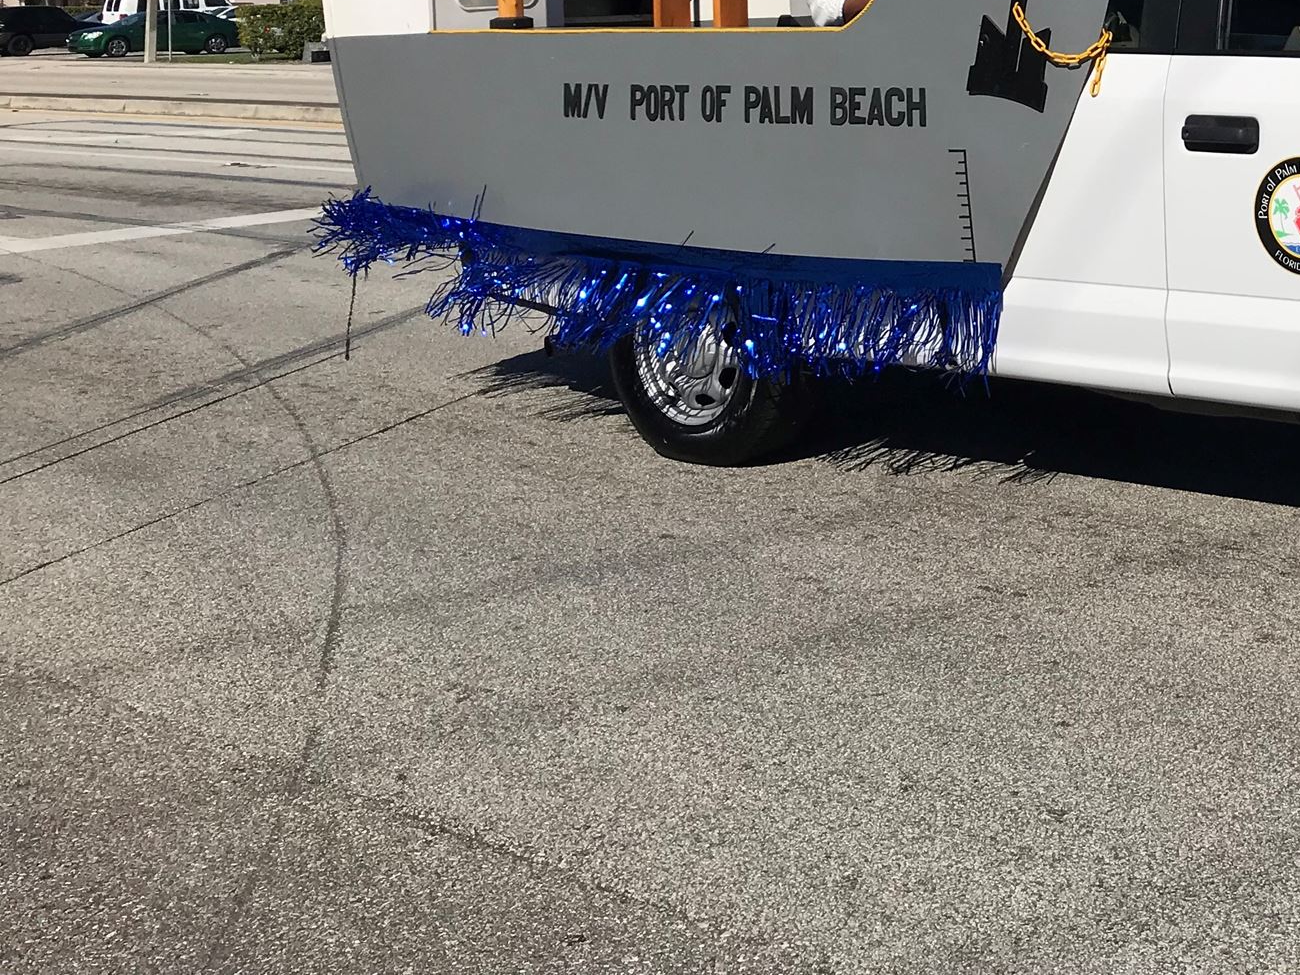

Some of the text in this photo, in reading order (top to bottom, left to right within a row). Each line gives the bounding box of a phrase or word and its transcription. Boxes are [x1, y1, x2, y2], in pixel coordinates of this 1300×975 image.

[563, 83, 927, 127] M/V PORT OF PALM BEACH
